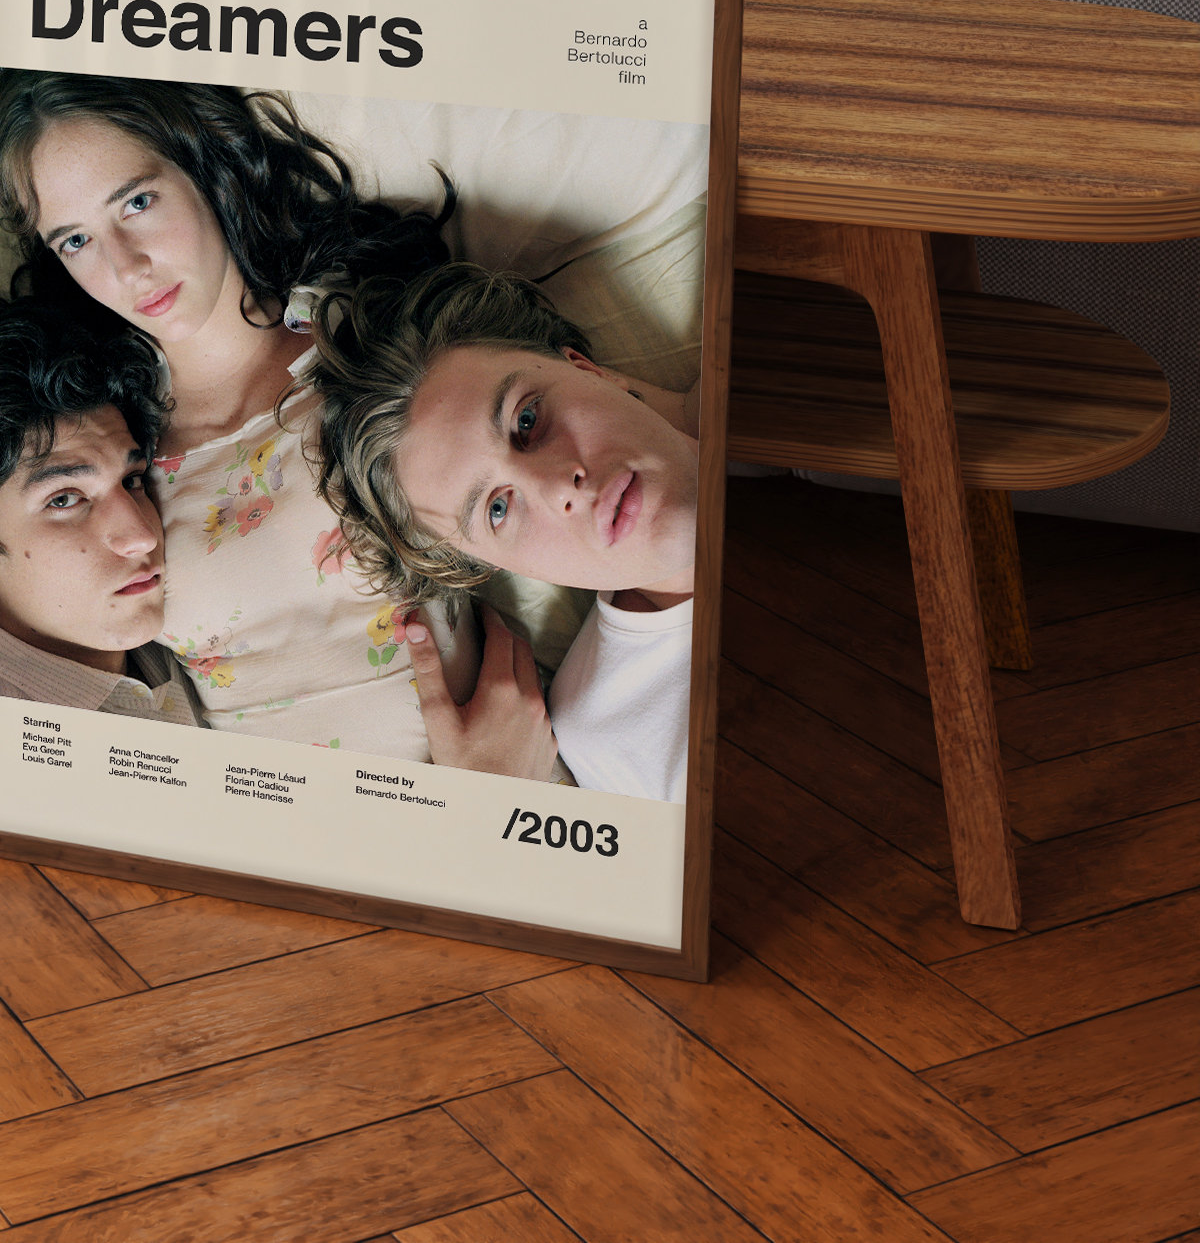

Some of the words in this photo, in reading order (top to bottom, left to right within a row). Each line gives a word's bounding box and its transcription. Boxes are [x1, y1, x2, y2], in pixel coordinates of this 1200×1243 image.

[638, 19, 648, 30] a
[574, 31, 647, 49] Bernardo
[567, 48, 646, 67] Bertolucci
[618, 70, 646, 85] film
[24, 717, 61, 732] Starring
[22, 732, 55, 744] Michael
[58, 737, 72, 747] Pitt
[22, 743, 38, 752] Eva
[40, 745, 65, 756] Green
[110, 746, 131, 756] Anna
[134, 750, 179, 764] Chancellor
[22, 753, 45, 764] Louis
[47, 757, 72, 768] Garrel
[110, 757, 134, 768] Robin
[137, 762, 171, 774] Renucci
[109, 768, 157, 782] Jean-Pierre
[160, 776, 187, 787] Kalfon
[226, 764, 275, 779] Jean-Pierre
[279, 772, 306, 784] Léaud
[356, 770, 399, 784] Directed
[402, 777, 414, 788] by
[225, 775, 254, 786] Florian
[258, 781, 289, 792] Cadiou
[225, 786, 250, 797] Pierre
[253, 790, 293, 804] Hancisse
[356, 786, 397, 800] Bernardo
[400, 794, 446, 808] Bertolucci
[502, 808, 619, 857] /2003
